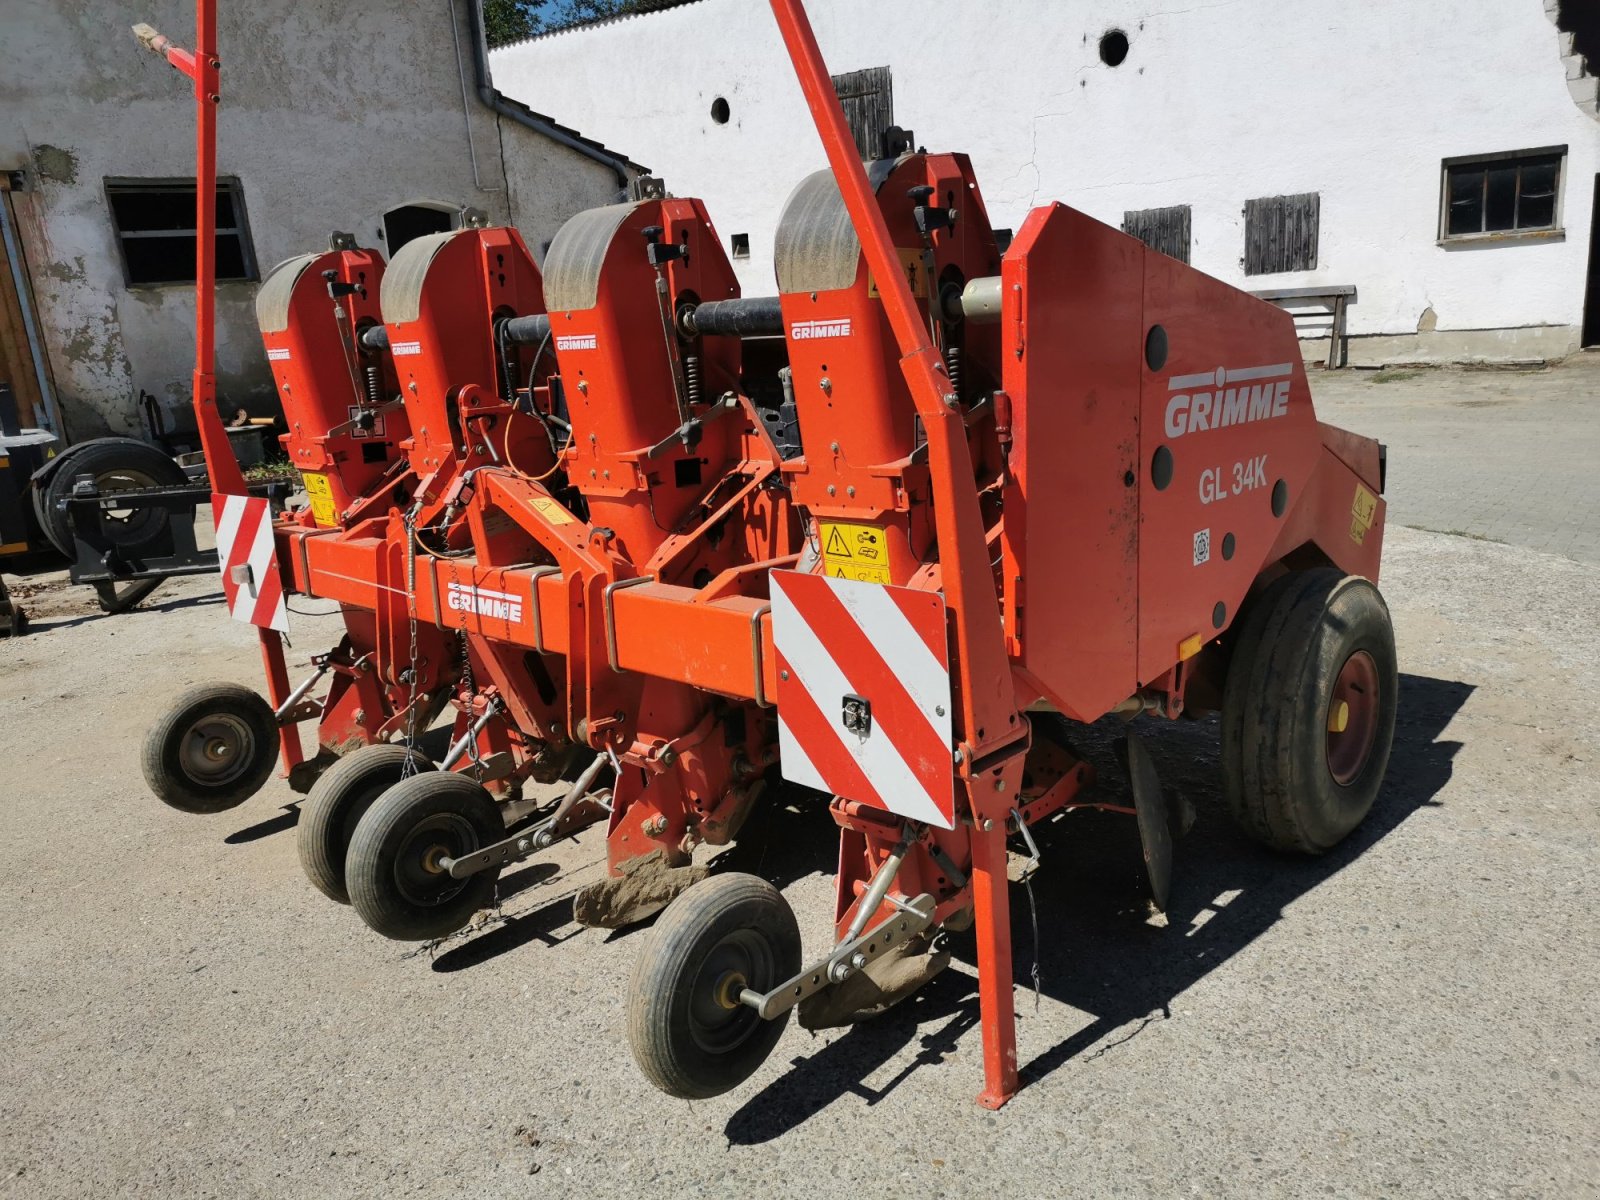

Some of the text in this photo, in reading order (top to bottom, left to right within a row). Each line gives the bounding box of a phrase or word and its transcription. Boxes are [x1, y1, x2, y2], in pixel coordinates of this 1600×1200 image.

[556, 337, 597, 350] GRIMME
[791, 321, 851, 340] GRIMME
[1164, 379, 1291, 439] GRIMME
[1199, 454, 1268, 505] GL 34K
[447, 588, 522, 623] GRIMME
